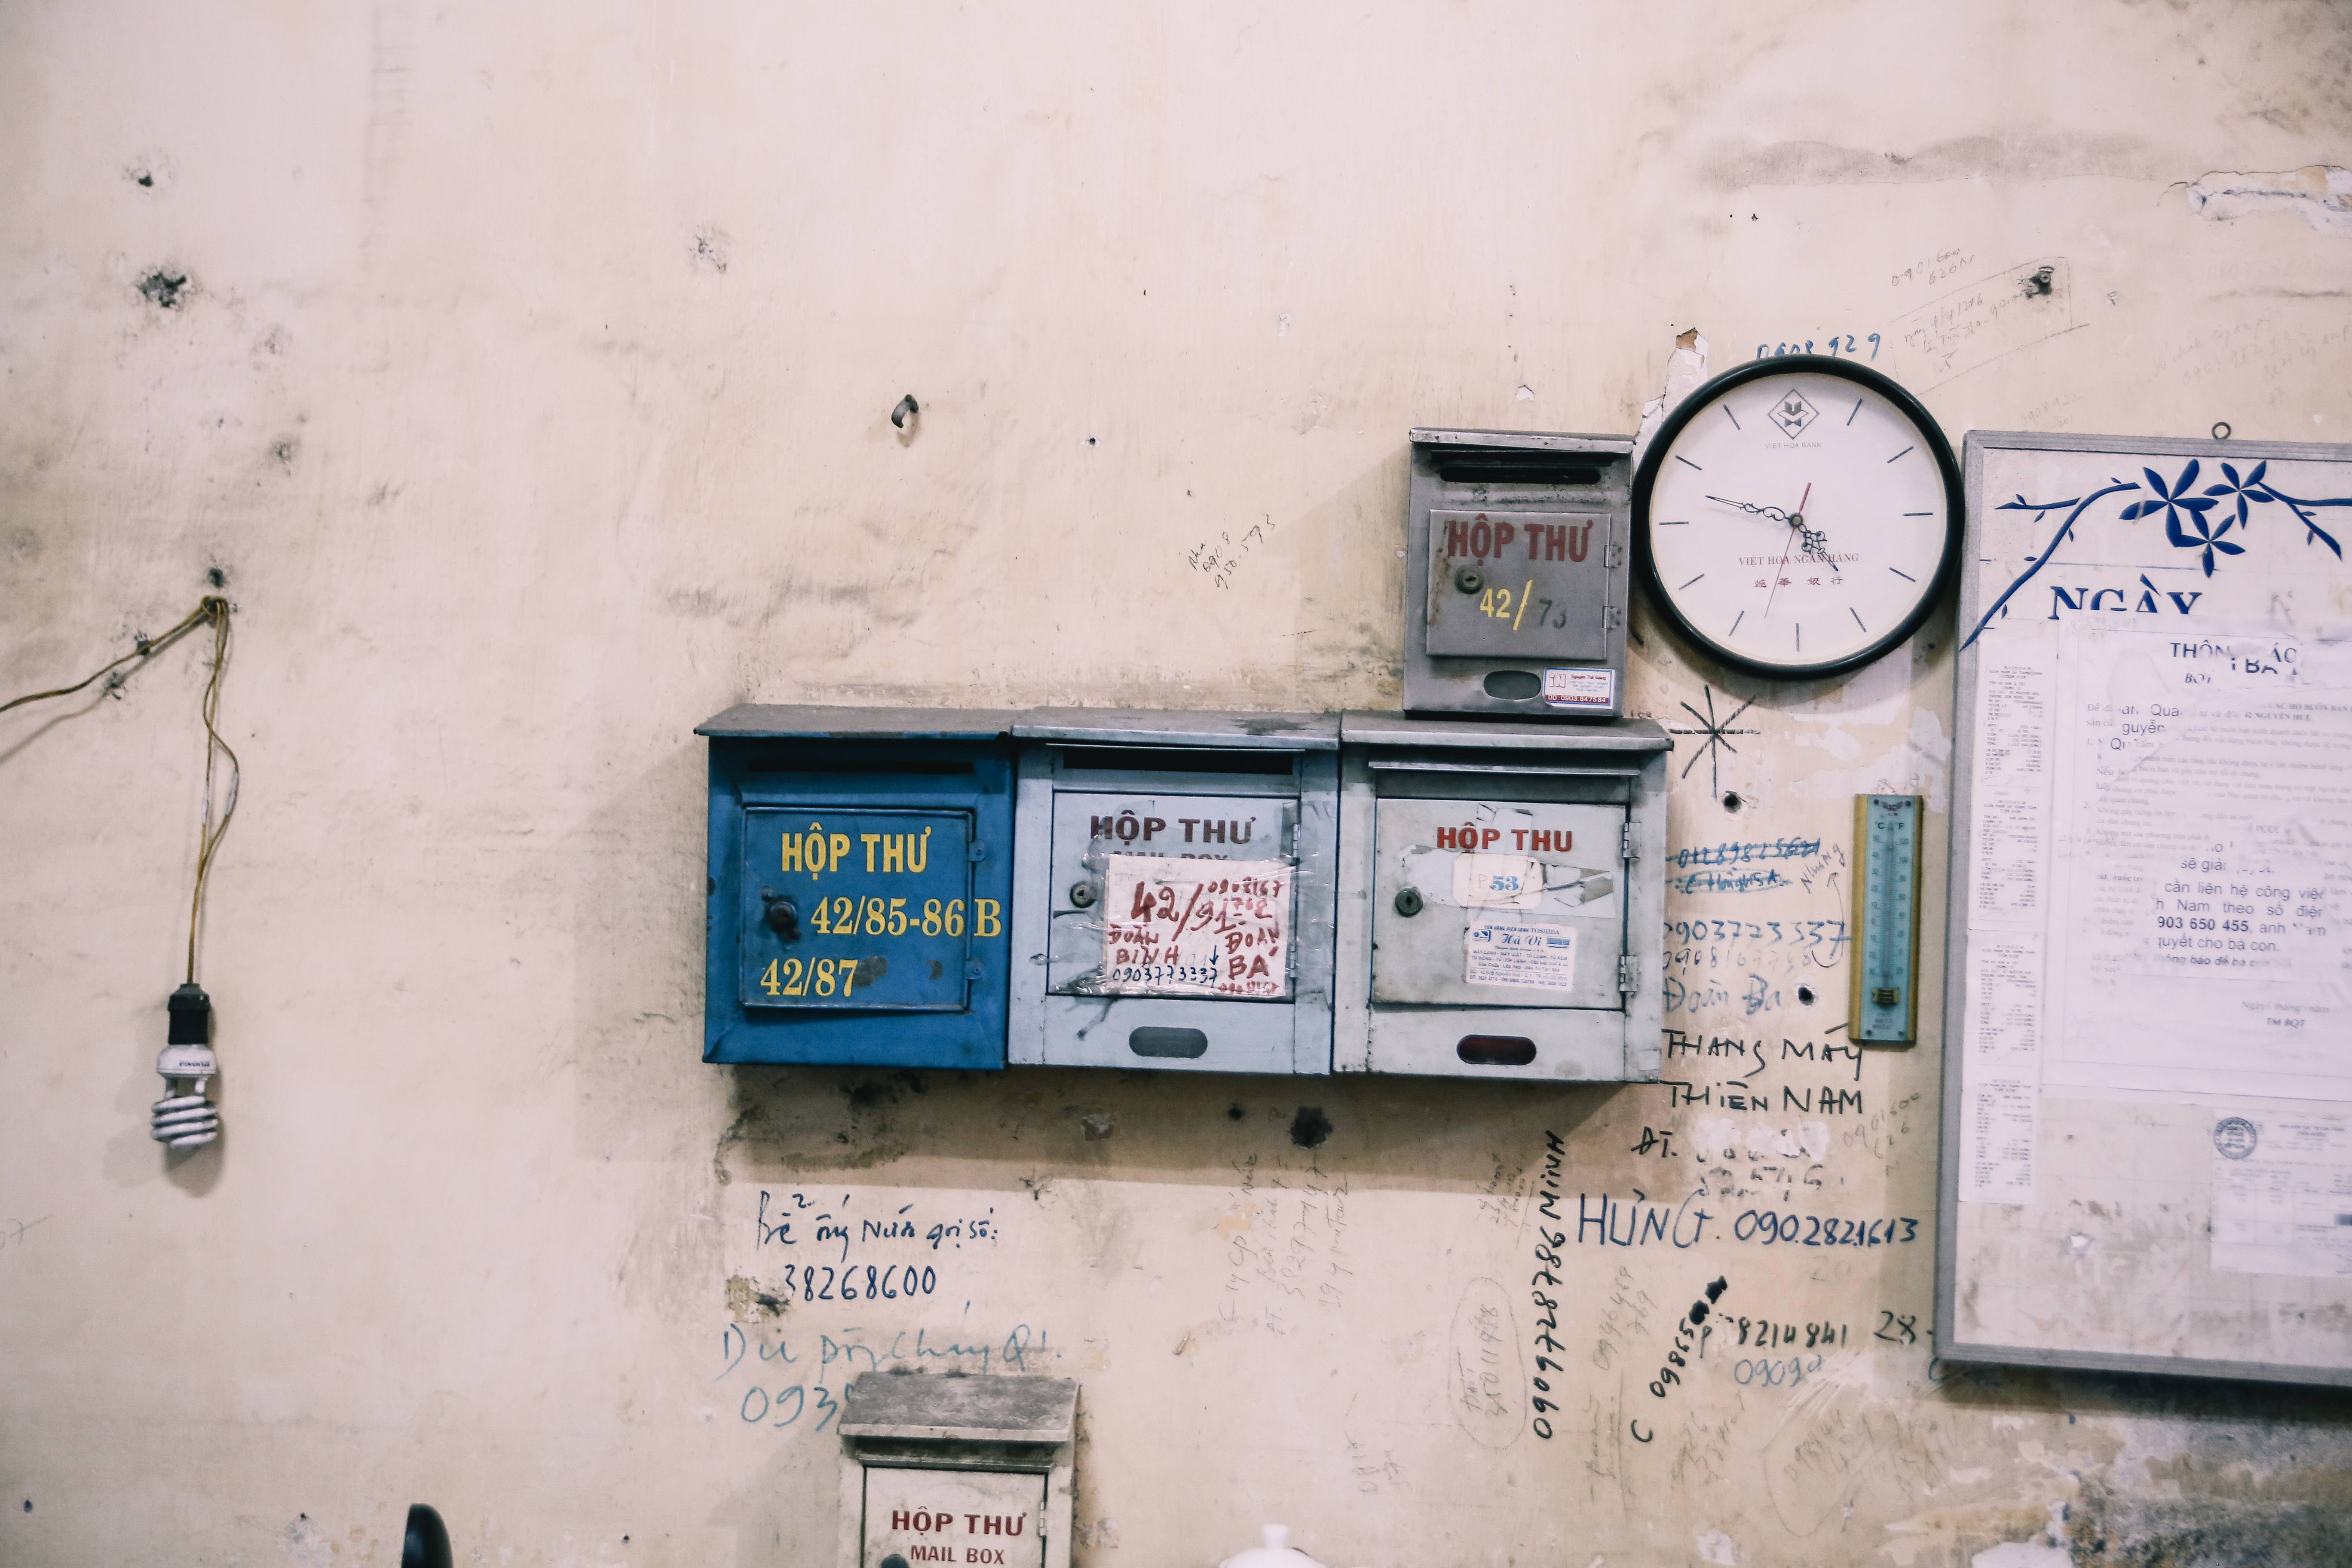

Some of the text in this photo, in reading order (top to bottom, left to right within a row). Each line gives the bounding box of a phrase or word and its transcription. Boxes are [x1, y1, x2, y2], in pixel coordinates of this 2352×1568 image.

[1448, 513, 1593, 566] HỘP THƯ
[2170, 640, 2231, 659] THÔN
[1090, 809, 1256, 845] HỘP THƯ
[1436, 821, 1501, 854] HỘP
[781, 822, 932, 881] HỘP THƯ
[1490, 875, 1519, 891] 53
[2197, 881, 2223, 895] liên
[2230, 883, 2249, 897] hệ
[2255, 886, 2291, 901] công
[810, 895, 1001, 937] 42/85-86 B
[2177, 898, 2210, 913] Nam
[2223, 901, 2254, 915] theo
[2189, 917, 2216, 931] 650
[2259, 922, 2286, 935] anh
[2197, 937, 2223, 949] cho
[760, 956, 859, 997] 42/87
[784, 1263, 937, 1302] 38268600
[891, 1505, 1027, 1539] HỘP THƯ
[910, 1544, 1006, 1565] MAIL BOX
